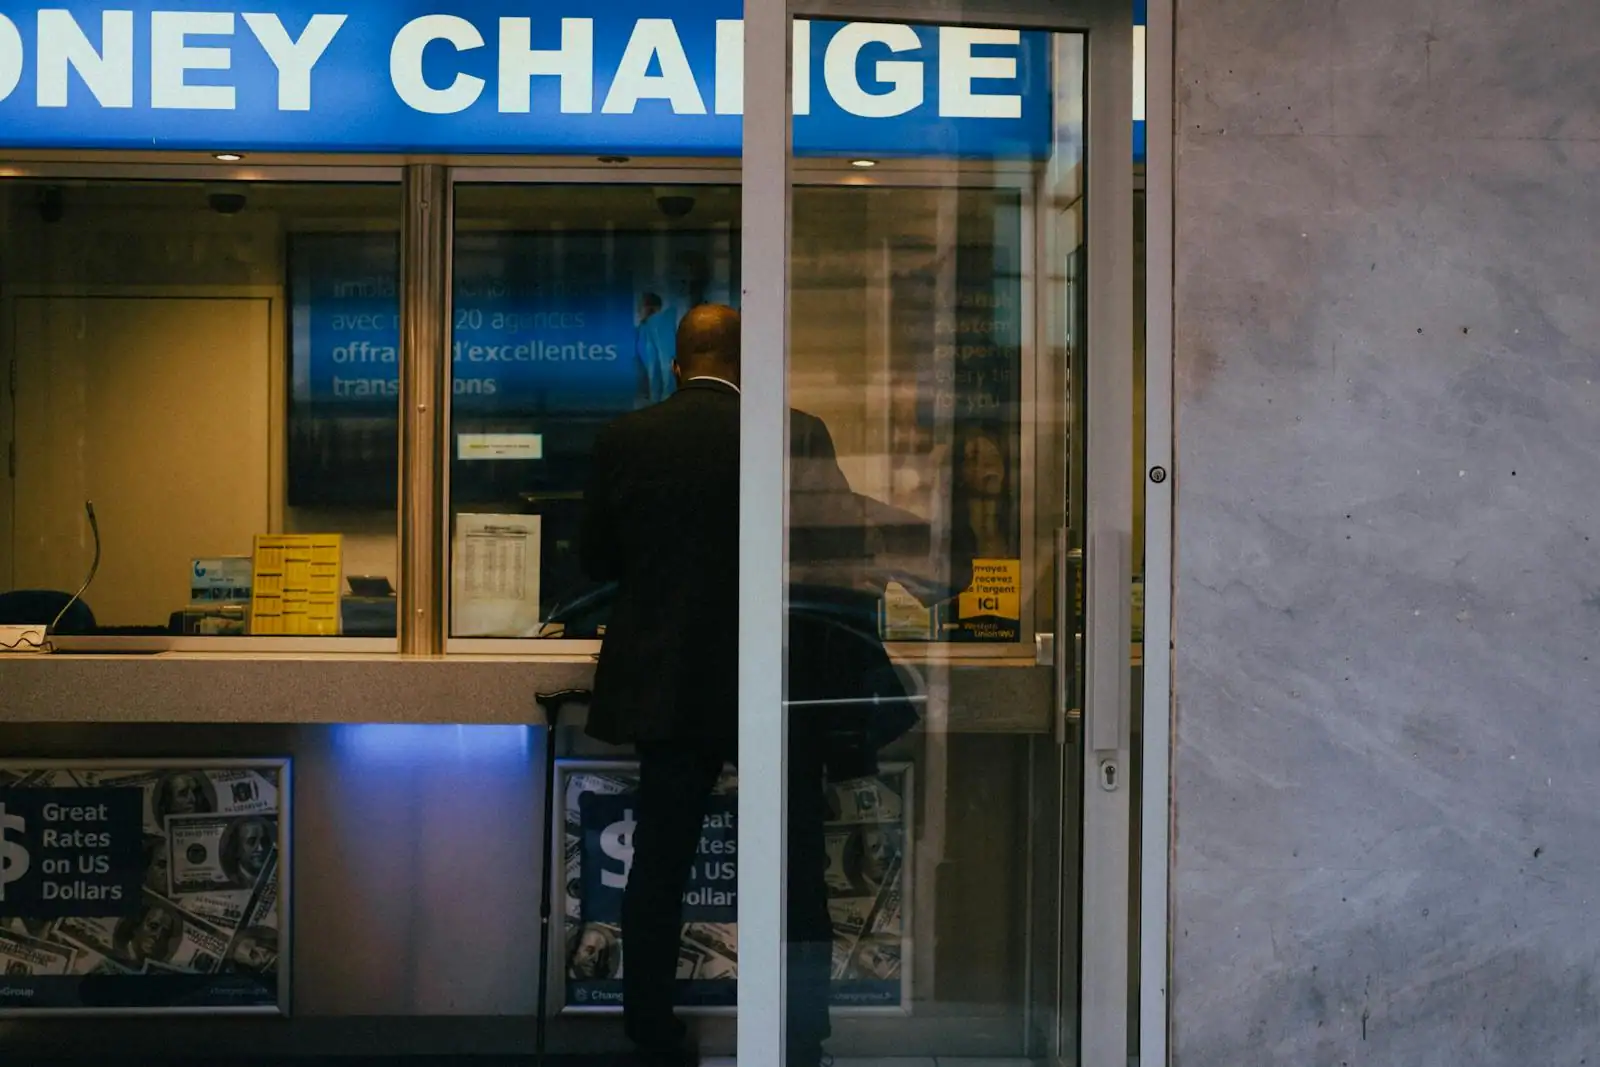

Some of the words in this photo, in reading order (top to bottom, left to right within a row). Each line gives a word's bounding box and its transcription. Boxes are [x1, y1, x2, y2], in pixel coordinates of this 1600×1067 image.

[0, 9, 348, 111] NEY
[332, 313, 384, 331] avec
[491, 311, 586, 334] agences
[332, 341, 396, 363] offra
[453, 339, 617, 362] d'excellentes
[332, 374, 497, 396] transons
[974, 566, 1008, 574] nvoyez
[977, 597, 999, 611] ICI
[42, 802, 108, 821] Great
[702, 811, 734, 828] eat
[42, 829, 111, 848] Rates
[696, 837, 736, 854] tes
[42, 859, 70, 874] on
[78, 855, 110, 874] US
[705, 861, 736, 880] US
[42, 881, 122, 900] Dollars
[682, 887, 737, 905] ollar
